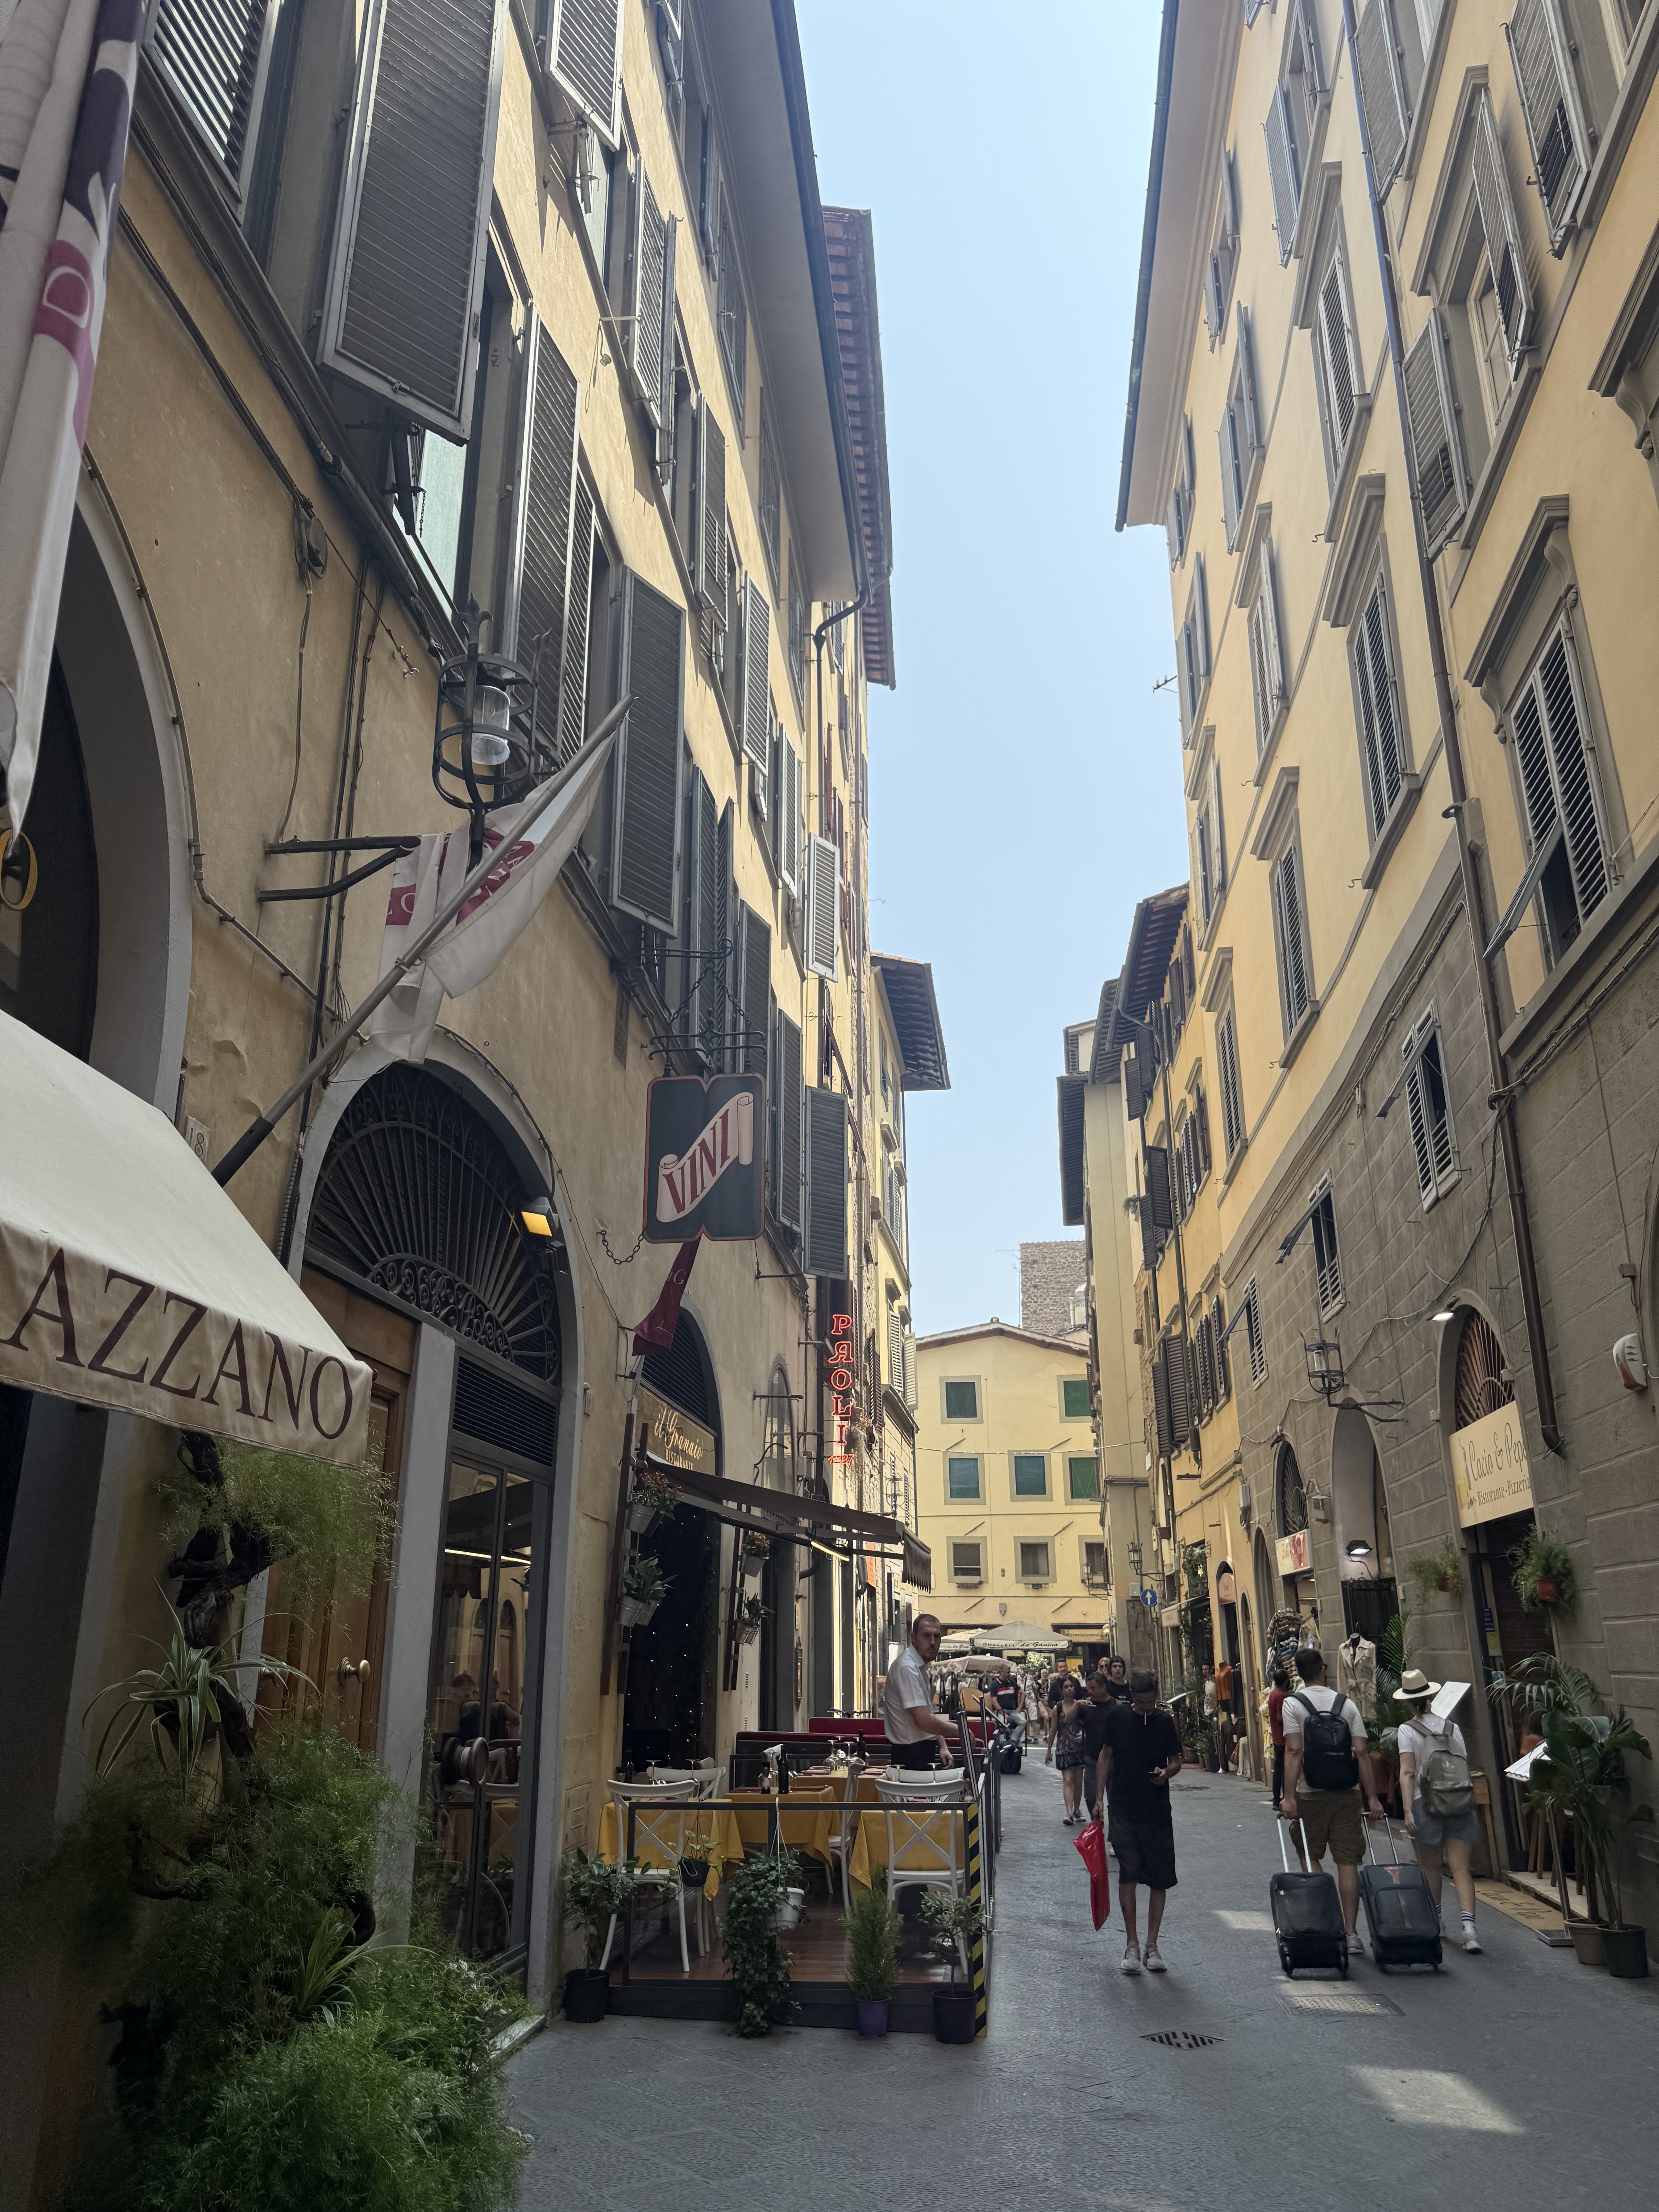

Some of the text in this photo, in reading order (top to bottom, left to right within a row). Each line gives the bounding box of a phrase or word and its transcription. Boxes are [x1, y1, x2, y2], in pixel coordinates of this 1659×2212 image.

[189, 1127, 204, 1157] 18
[662, 1108, 730, 1214] VINI
[0, 1248, 353, 1439] AZZANO
[828, 1314, 854, 1446] PAOLI
[665, 1409, 703, 1460] Granaio
[665, 1449, 694, 1470] RISTORANTE
[1469, 1441, 1493, 1481] Cacio
[1477, 1475, 1530, 1506] Ristorante Pizzeria
